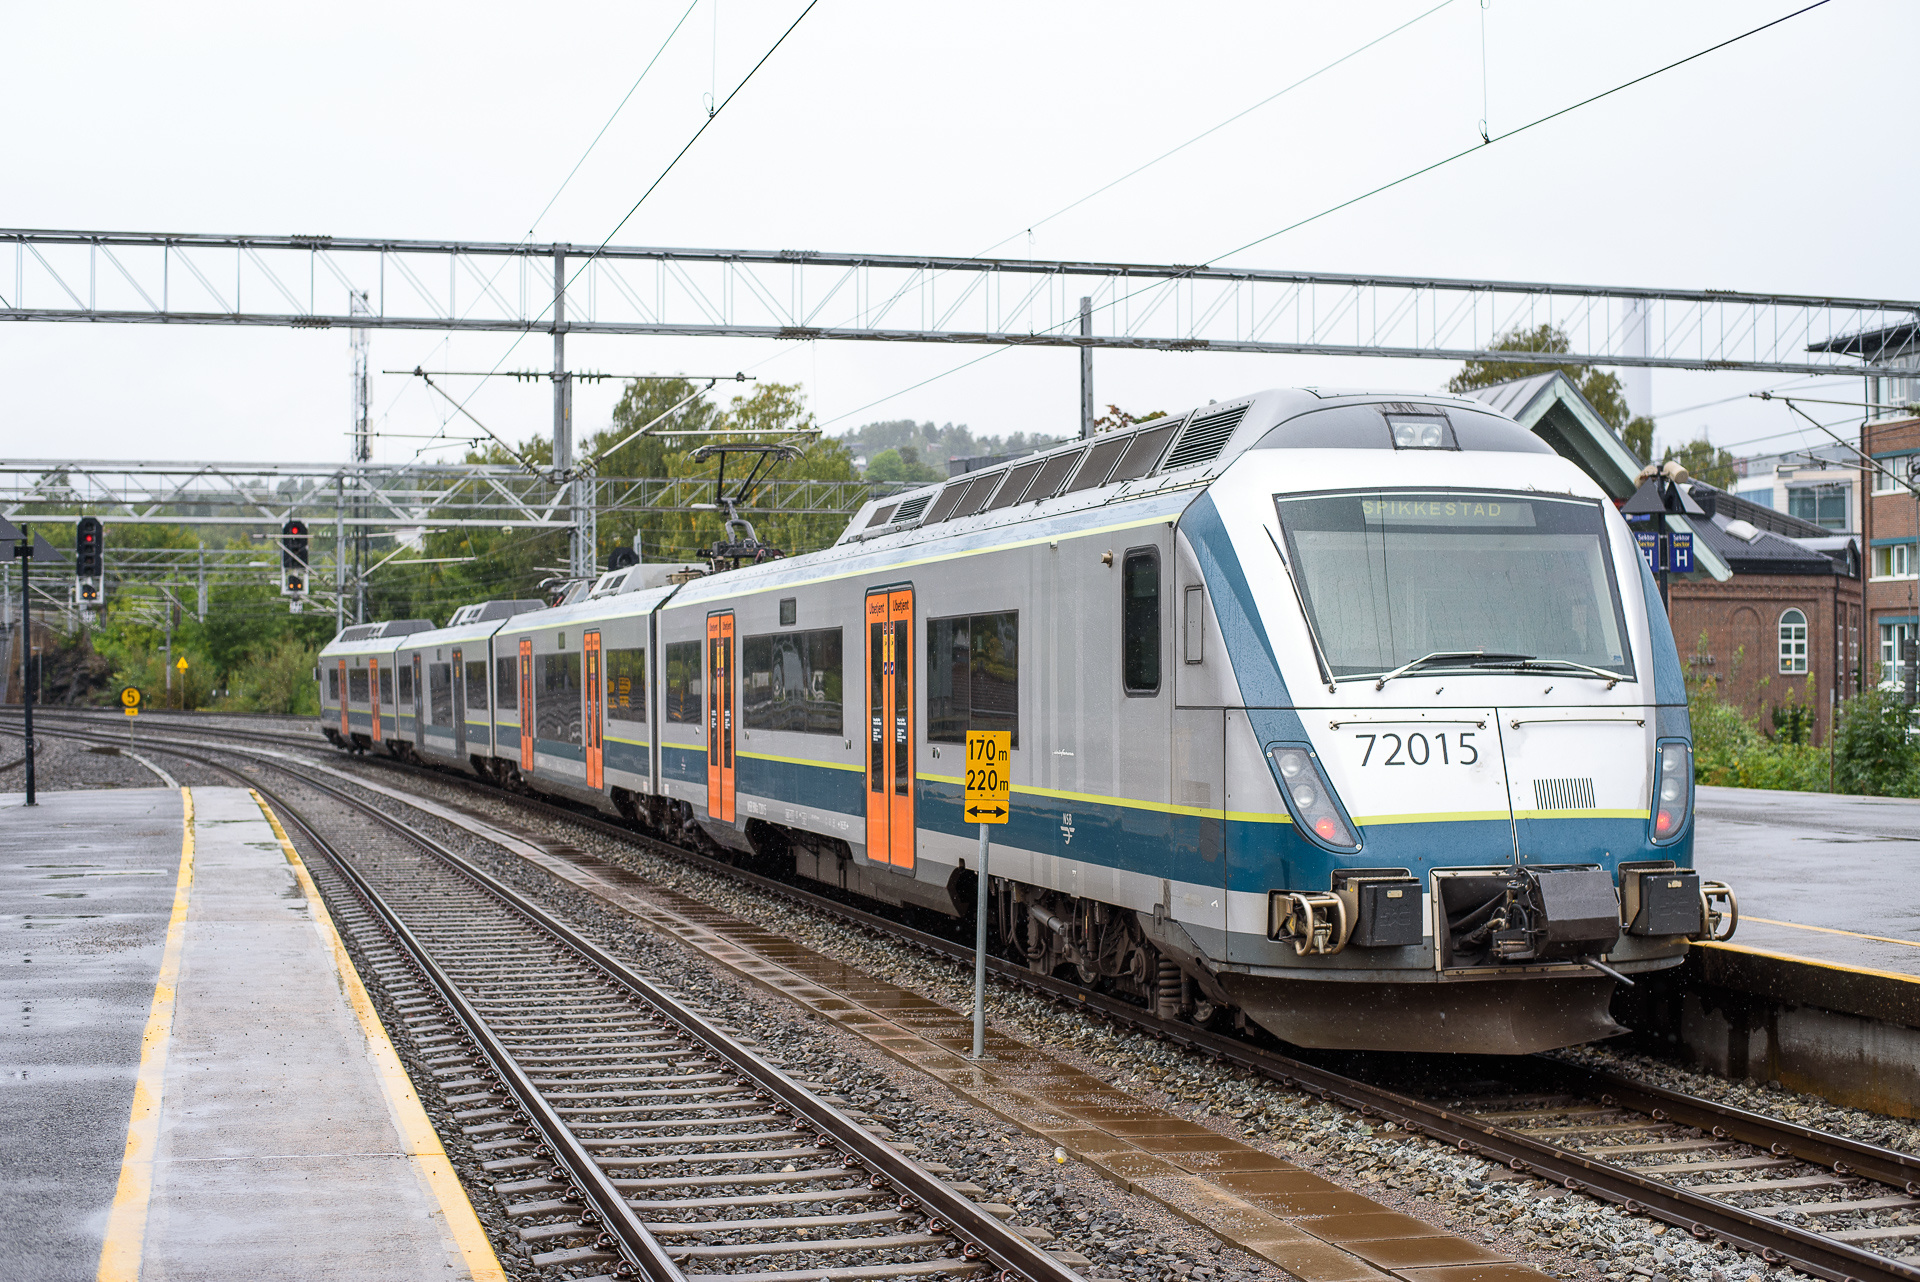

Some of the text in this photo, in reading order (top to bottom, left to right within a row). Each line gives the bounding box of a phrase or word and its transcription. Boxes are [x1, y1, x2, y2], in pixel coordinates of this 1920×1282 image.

[1362, 500, 1501, 517] SPIKKESTAD
[1637, 533, 1656, 541] Sektor
[1672, 533, 1691, 541] Sektor
[1676, 549, 1688, 567] H
[127, 690, 135, 704] 5
[969, 739, 1008, 761] 170 m
[1355, 732, 1479, 766] 72015
[966, 769, 1009, 791] 220 m
[1062, 813, 1073, 825] NSB
